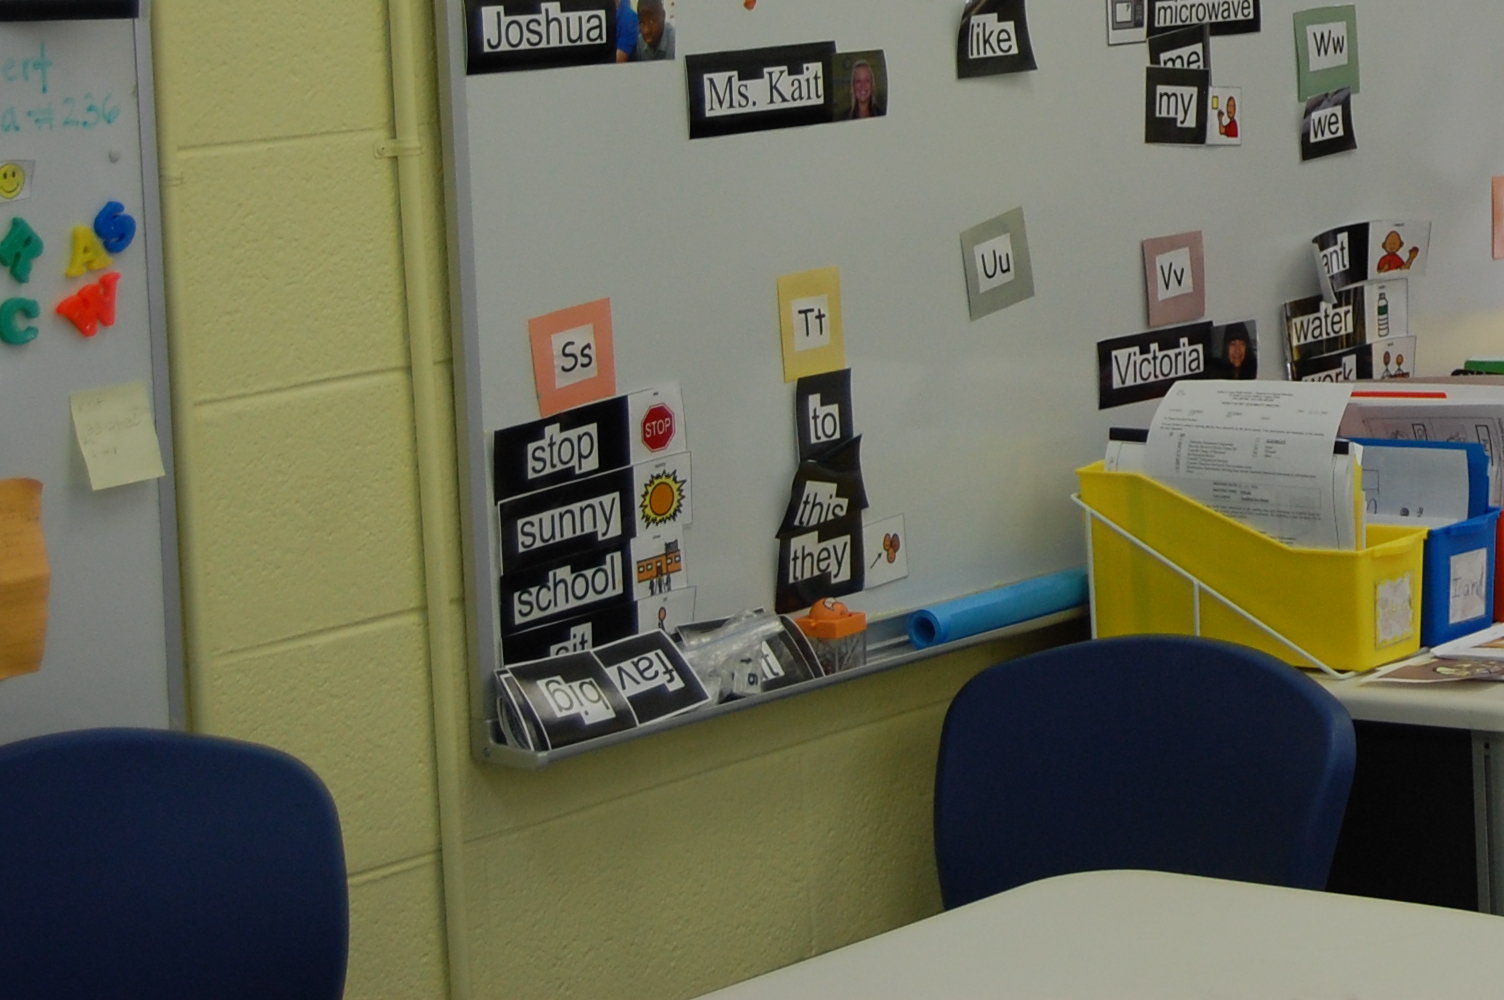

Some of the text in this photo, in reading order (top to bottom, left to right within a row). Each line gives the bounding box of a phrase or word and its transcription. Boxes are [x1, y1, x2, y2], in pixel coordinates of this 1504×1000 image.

[486, 6, 605, 51] Joshua
[968, 21, 1014, 57] like
[1312, 29, 1345, 58] Ww
[1163, 50, 1201, 70] me
[706, 65, 823, 113] Ms. Kait
[1157, 89, 1195, 126] my
[1312, 113, 1341, 140] we
[64, 223, 114, 279] A
[981, 248, 1012, 281] Uu
[1160, 260, 1186, 292] Vv
[0, 297, 41, 346] C
[797, 307, 827, 337] Tt
[1293, 308, 1353, 345] water
[560, 340, 593, 374] Ss
[1113, 345, 1202, 387] Victoria
[645, 417, 671, 438] STOP
[811, 406, 838, 441] to
[530, 429, 595, 475] stop
[520, 495, 616, 550] sunny
[798, 491, 845, 527] this
[791, 541, 848, 583] they
[517, 563, 618, 618] school
[546, 679, 610, 715] big
